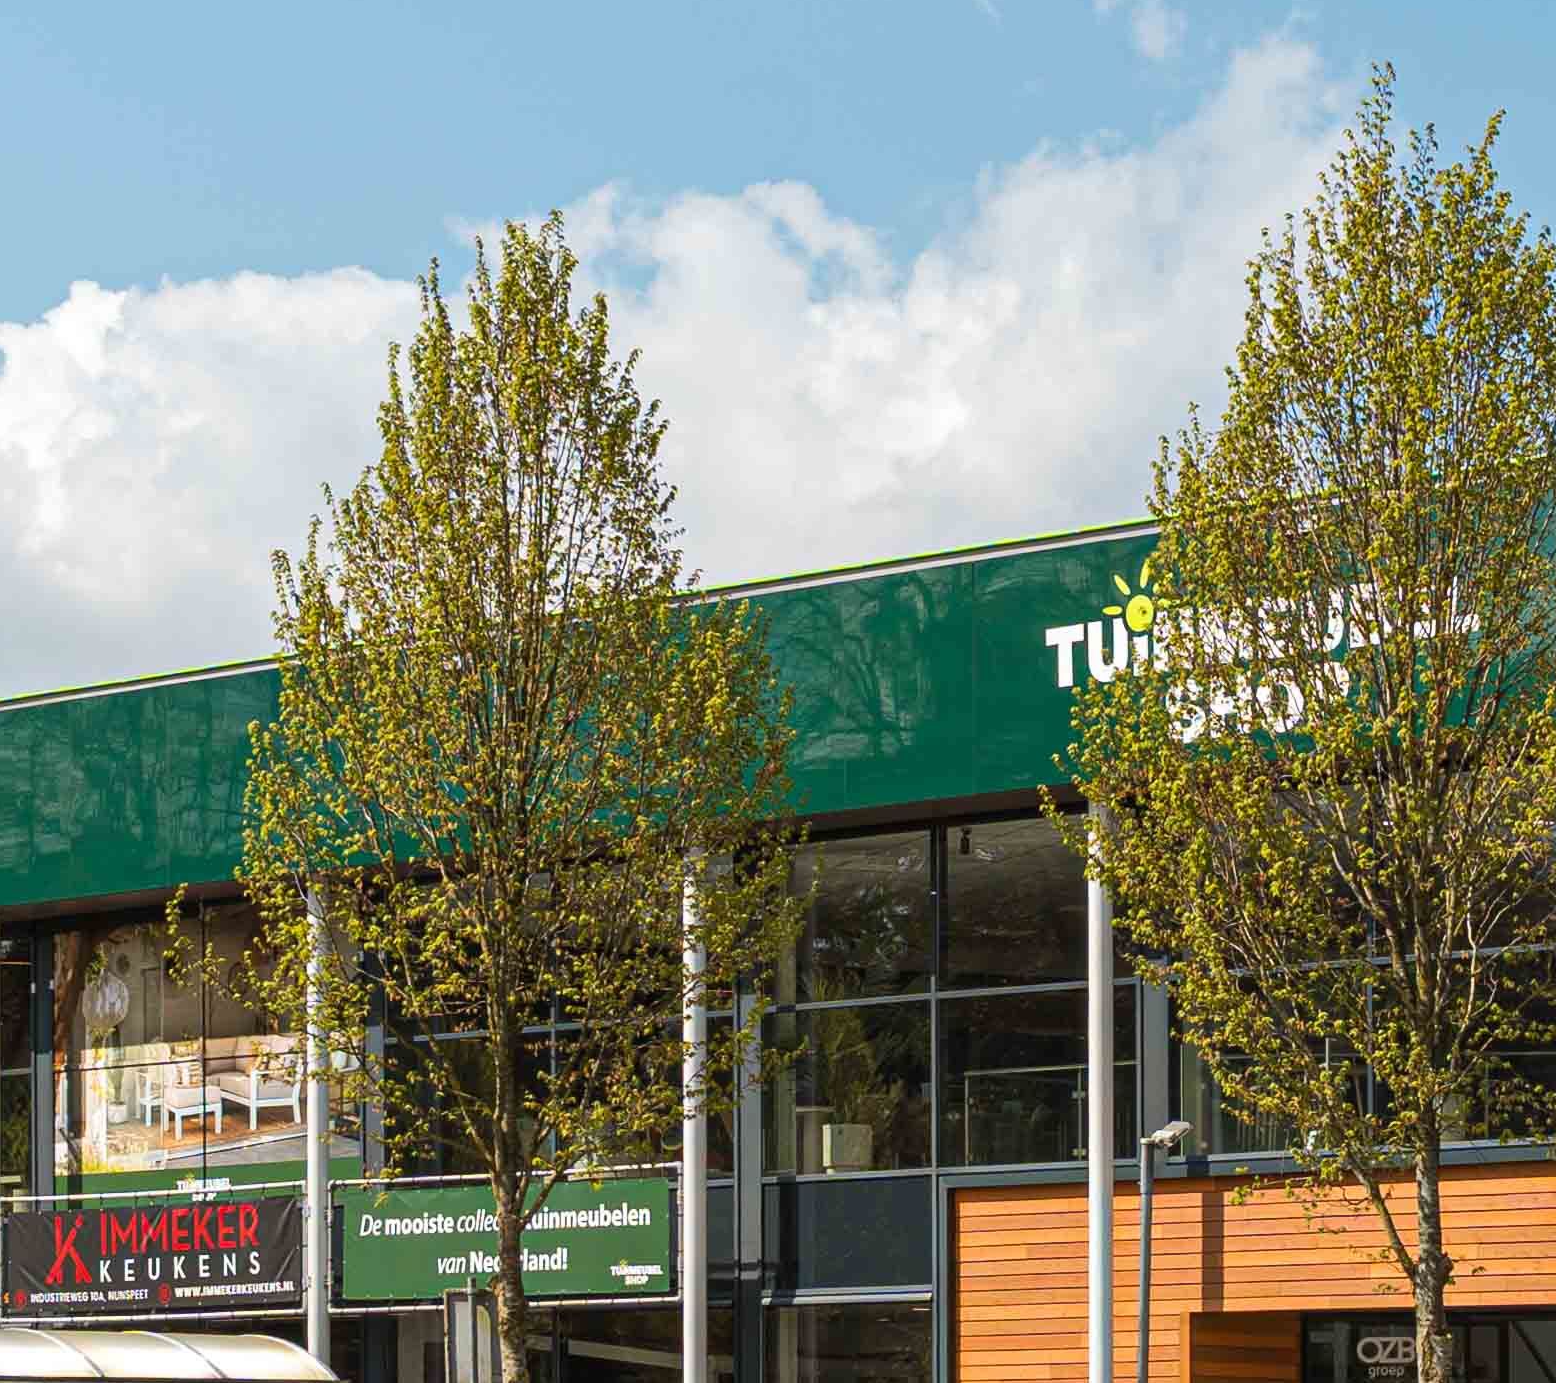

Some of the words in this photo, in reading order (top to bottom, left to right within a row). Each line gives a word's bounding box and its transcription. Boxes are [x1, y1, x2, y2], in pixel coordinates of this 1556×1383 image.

[100, 1204, 260, 1256] IMMEKER
[360, 1214, 382, 1237] De
[385, 1212, 454, 1236] mooiste
[525, 1202, 650, 1231] uinmeubelen
[100, 1252, 261, 1283] KEUKENS
[437, 1254, 467, 1274] van
[1356, 1337, 1417, 1364] OZB
[1368, 1366, 1404, 1378] groep
